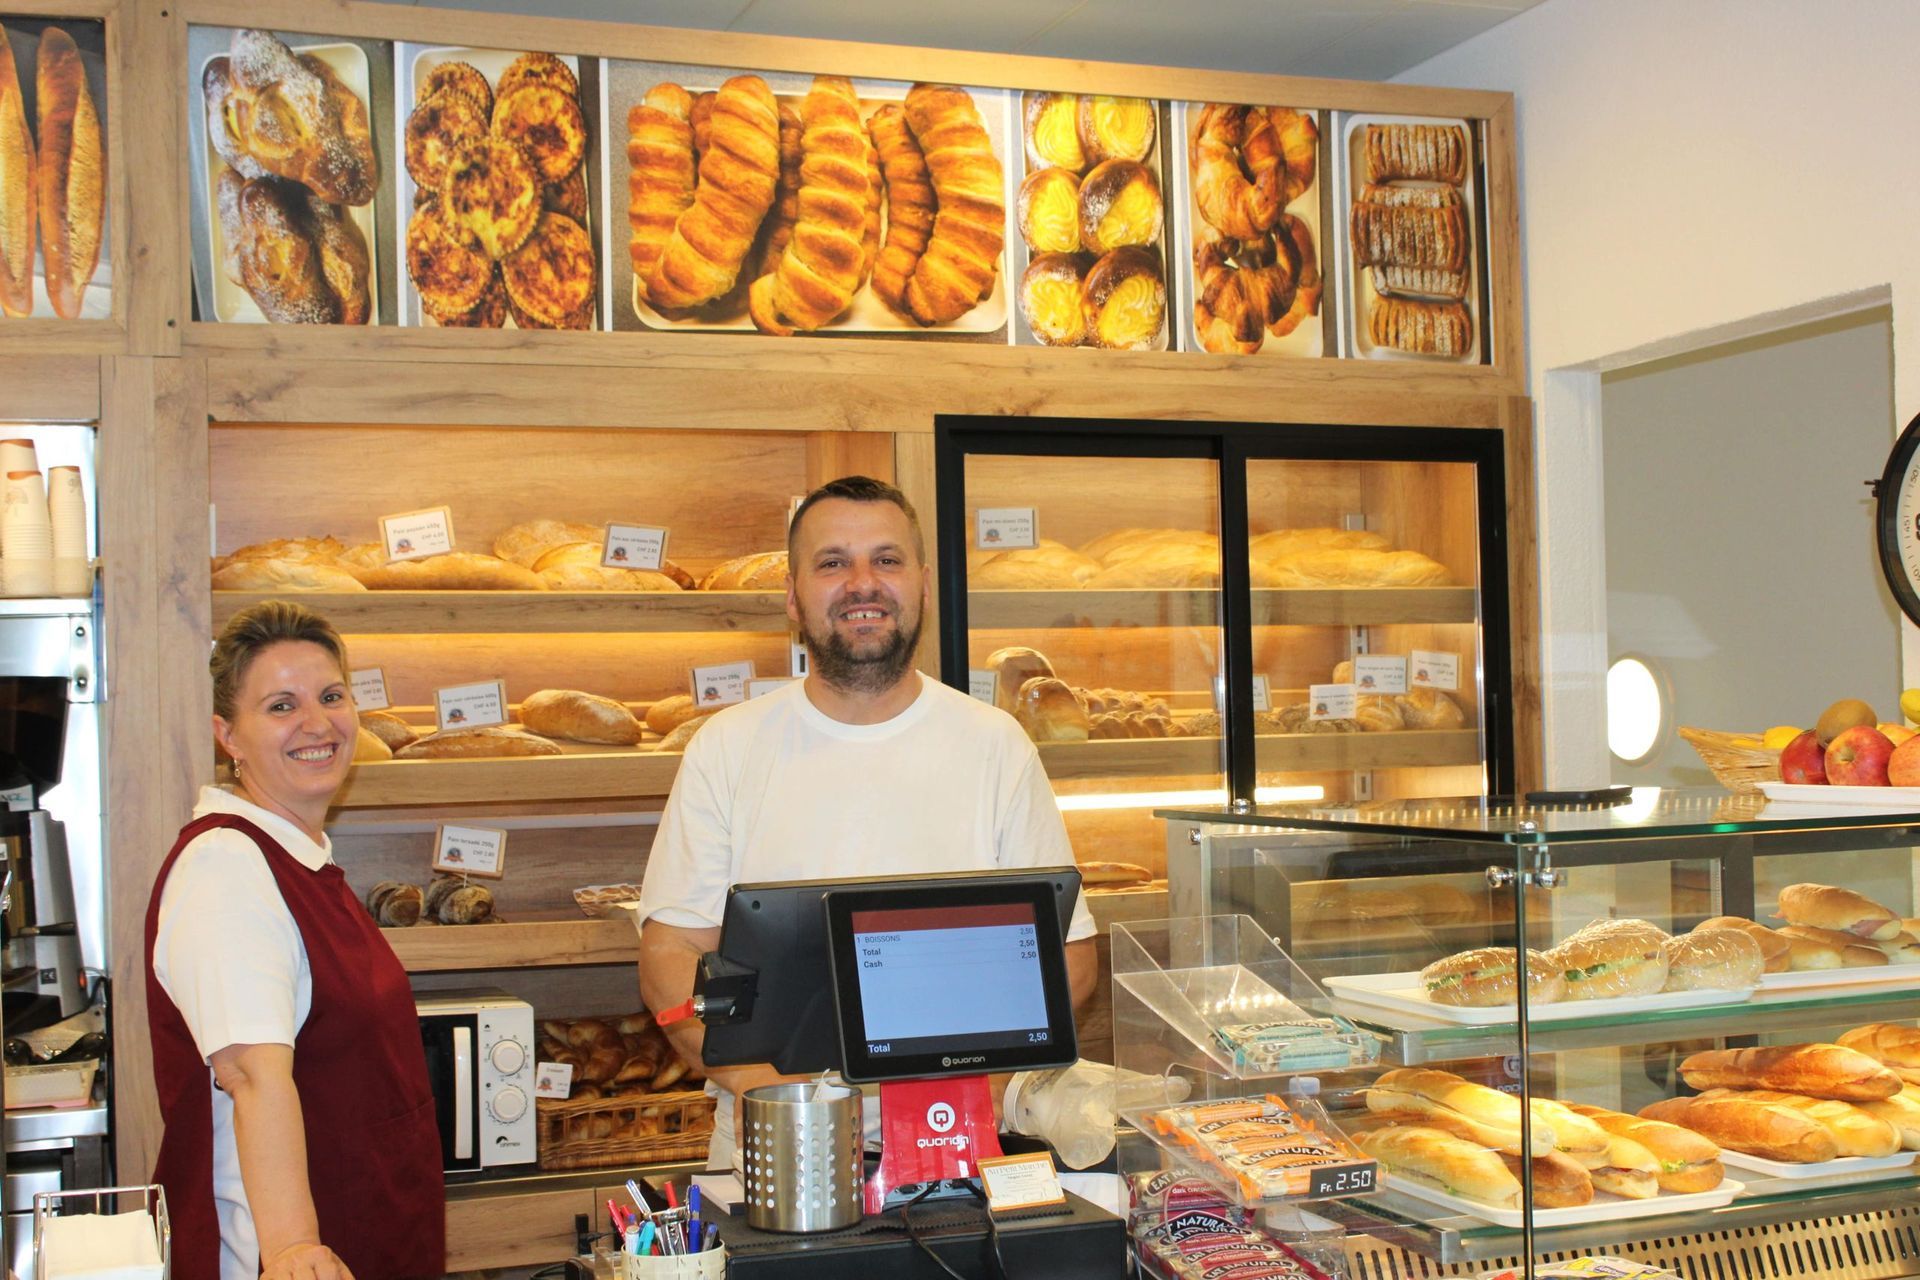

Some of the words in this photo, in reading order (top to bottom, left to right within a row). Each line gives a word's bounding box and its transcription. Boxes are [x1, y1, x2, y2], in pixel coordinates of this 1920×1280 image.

[862, 948, 882, 956] Total
[1019, 939, 1035, 948] 2,50
[864, 935, 901, 943] BOISSONS
[863, 960, 883, 968] Cash
[1021, 951, 1037, 960] 2,50
[868, 1042, 891, 1053] Total
[1028, 1032, 1048, 1043] 2,50
[1150, 1173, 1172, 1190] EAT
[1172, 1186, 1186, 1194] dark
[1320, 1182, 1333, 1193] Fr.
[1335, 1170, 1371, 1191] 2.50
